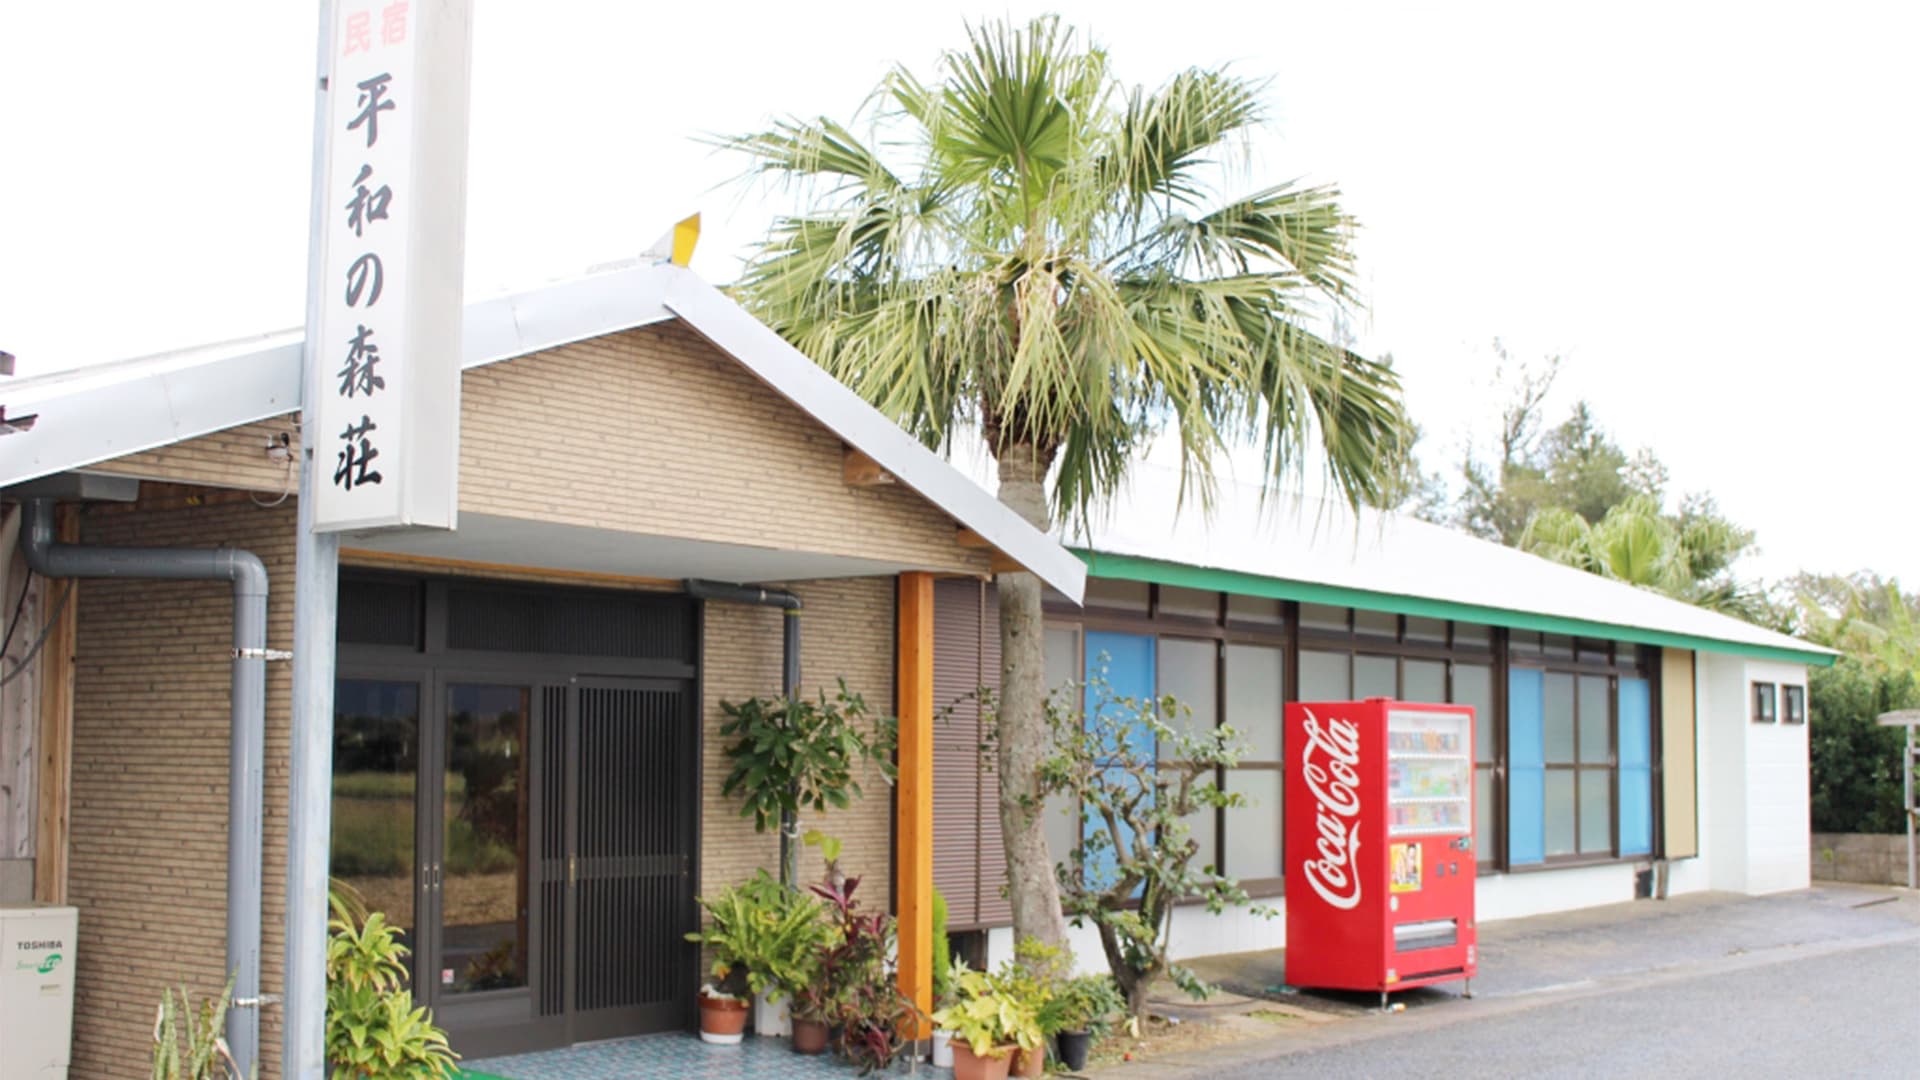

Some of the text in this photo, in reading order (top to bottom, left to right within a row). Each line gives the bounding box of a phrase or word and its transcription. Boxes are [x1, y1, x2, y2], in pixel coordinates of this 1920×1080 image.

[343, 0, 408, 56] 民宿
[334, 72, 396, 492] 平和の森荘
[1303, 707, 1361, 909] Coca-Cola
[17, 941, 63, 950] TOSHIBA
